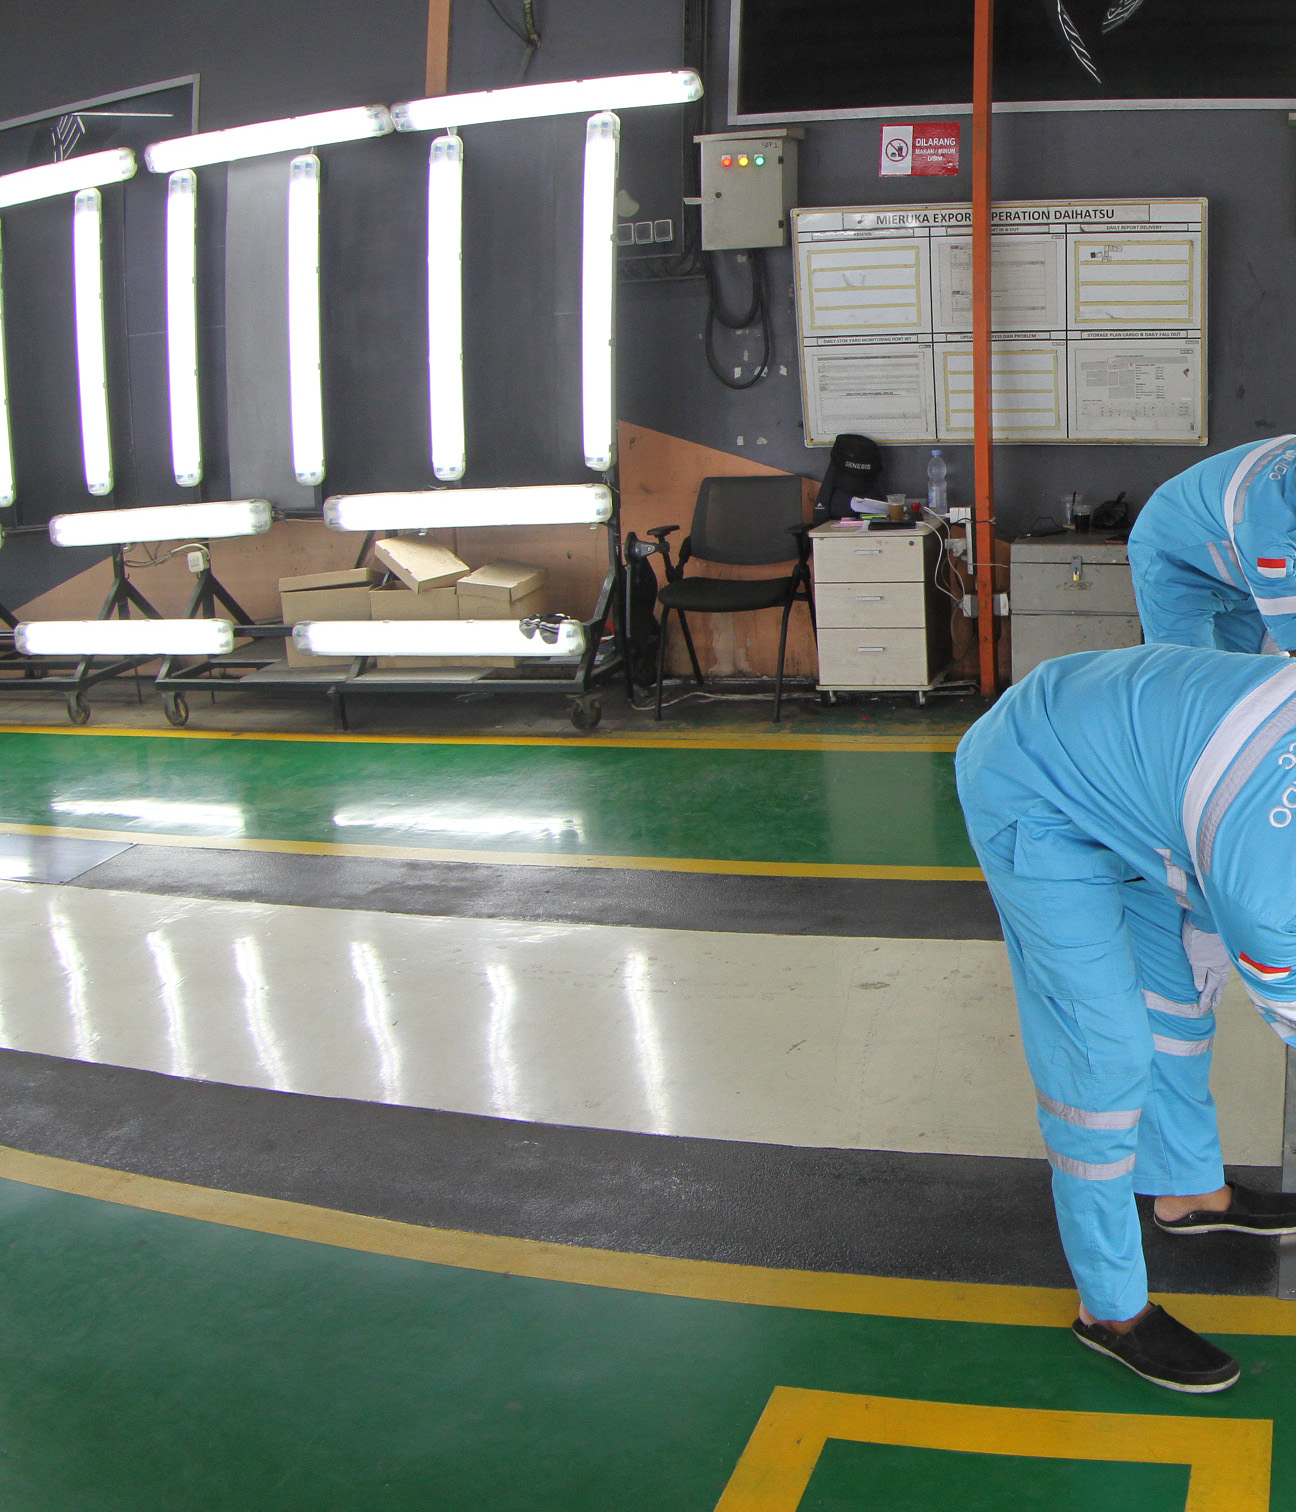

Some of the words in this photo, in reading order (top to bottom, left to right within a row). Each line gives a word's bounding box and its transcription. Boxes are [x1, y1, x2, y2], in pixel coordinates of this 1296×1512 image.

[915, 137, 956, 147] DILARANG
[876, 214, 930, 225] MIERUKA
[933, 212, 972, 223] EXPOR
[991, 209, 1050, 221] PERATION
[1054, 208, 1115, 220] DAIHATSU
[845, 461, 871, 470] GENESIS
